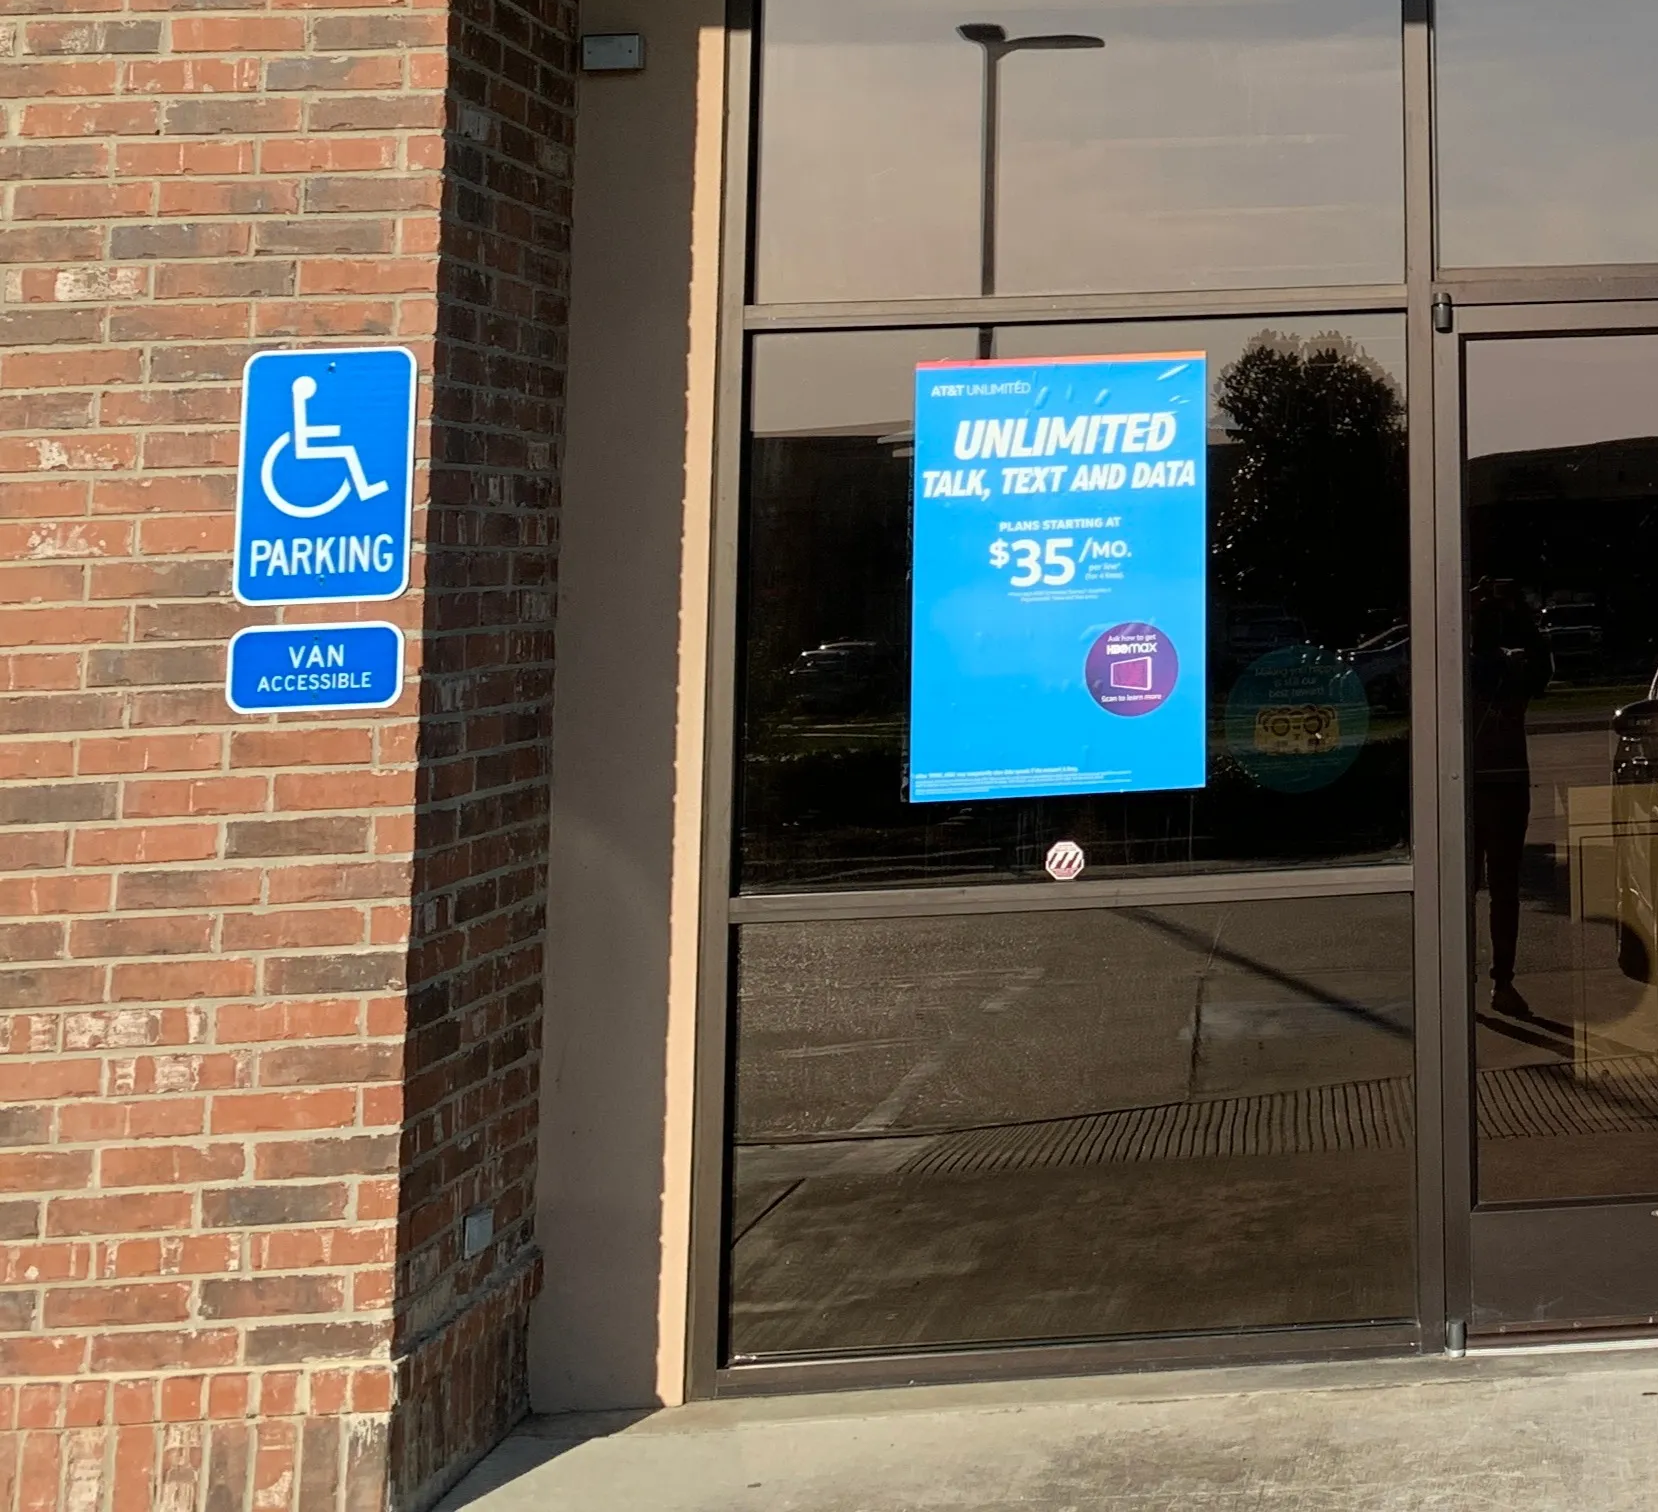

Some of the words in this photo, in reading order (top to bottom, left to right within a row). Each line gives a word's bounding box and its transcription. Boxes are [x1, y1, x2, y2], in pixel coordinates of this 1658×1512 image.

[930, 385, 965, 397] AT&T
[966, 381, 1032, 396] UNLIMITED
[953, 411, 1178, 460] UNLIMITED
[921, 468, 991, 502] TALK,
[1001, 465, 1068, 495] TEXT
[1068, 463, 1127, 492] AND
[1130, 460, 1195, 489] DATA
[999, 519, 1040, 533] PLANS
[1042, 517, 1104, 531] STARTING
[1104, 516, 1122, 529] AT
[249, 533, 395, 578] PARKING
[988, 537, 1076, 587] $35
[1107, 635, 1120, 643] Ask
[1145, 634, 1157, 643] get
[288, 644, 344, 669] VAN
[257, 672, 372, 693] ACCESSIBLE
[1101, 695, 1118, 703] Scan
